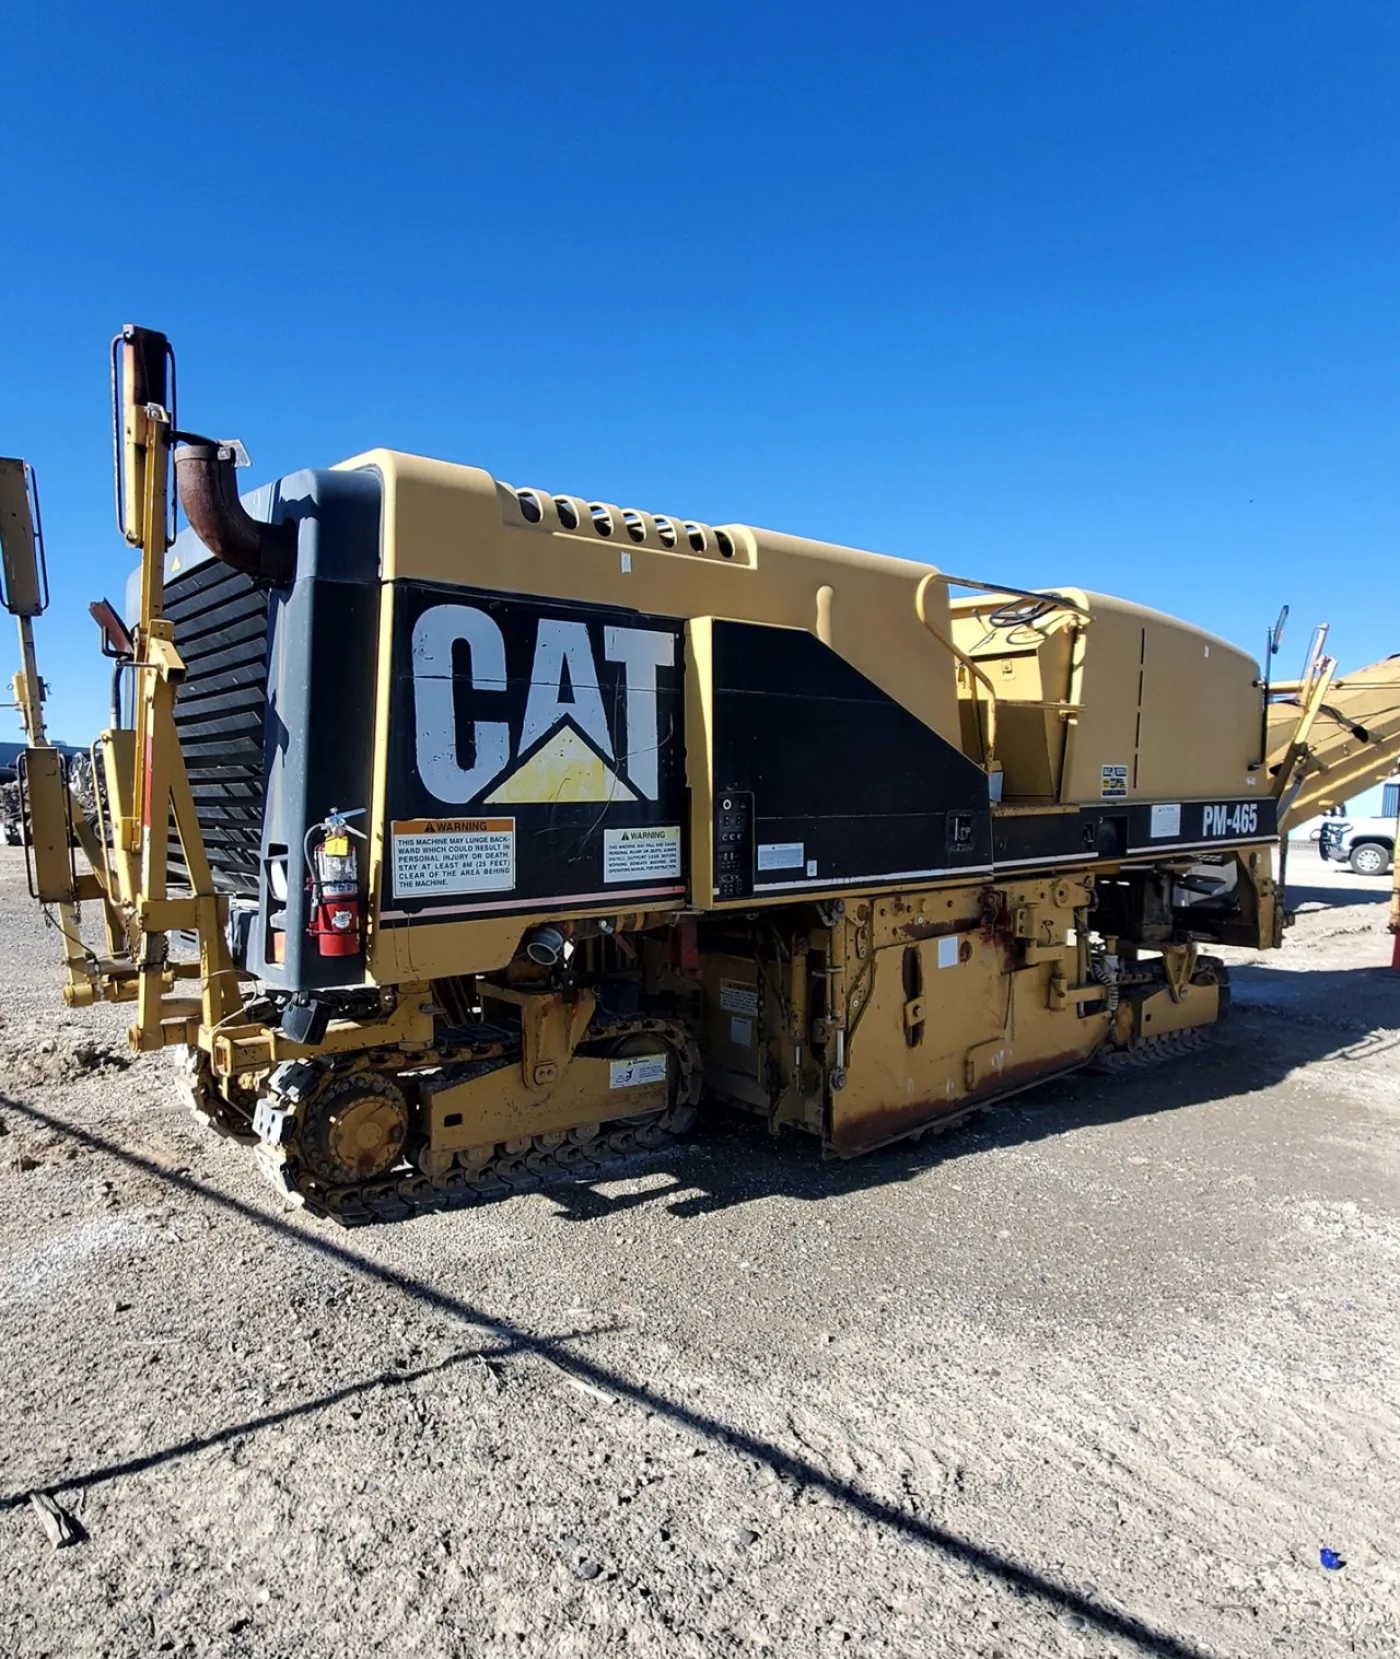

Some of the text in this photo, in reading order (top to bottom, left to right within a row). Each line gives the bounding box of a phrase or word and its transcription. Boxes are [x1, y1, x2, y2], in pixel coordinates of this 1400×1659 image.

[412, 604, 674, 804] CAT
[1202, 803, 1258, 837] PM-465
[437, 821, 487, 832] WARNING
[630, 831, 666, 840] WARNING
[398, 855, 440, 863] PERSONAL
[471, 852, 482, 860] OR
[476, 860, 487, 868] (25
[398, 872, 425, 880] CLEAR
[483, 867, 510, 875] BEHIND
[399, 879, 449, 888] THE MACHINE.
